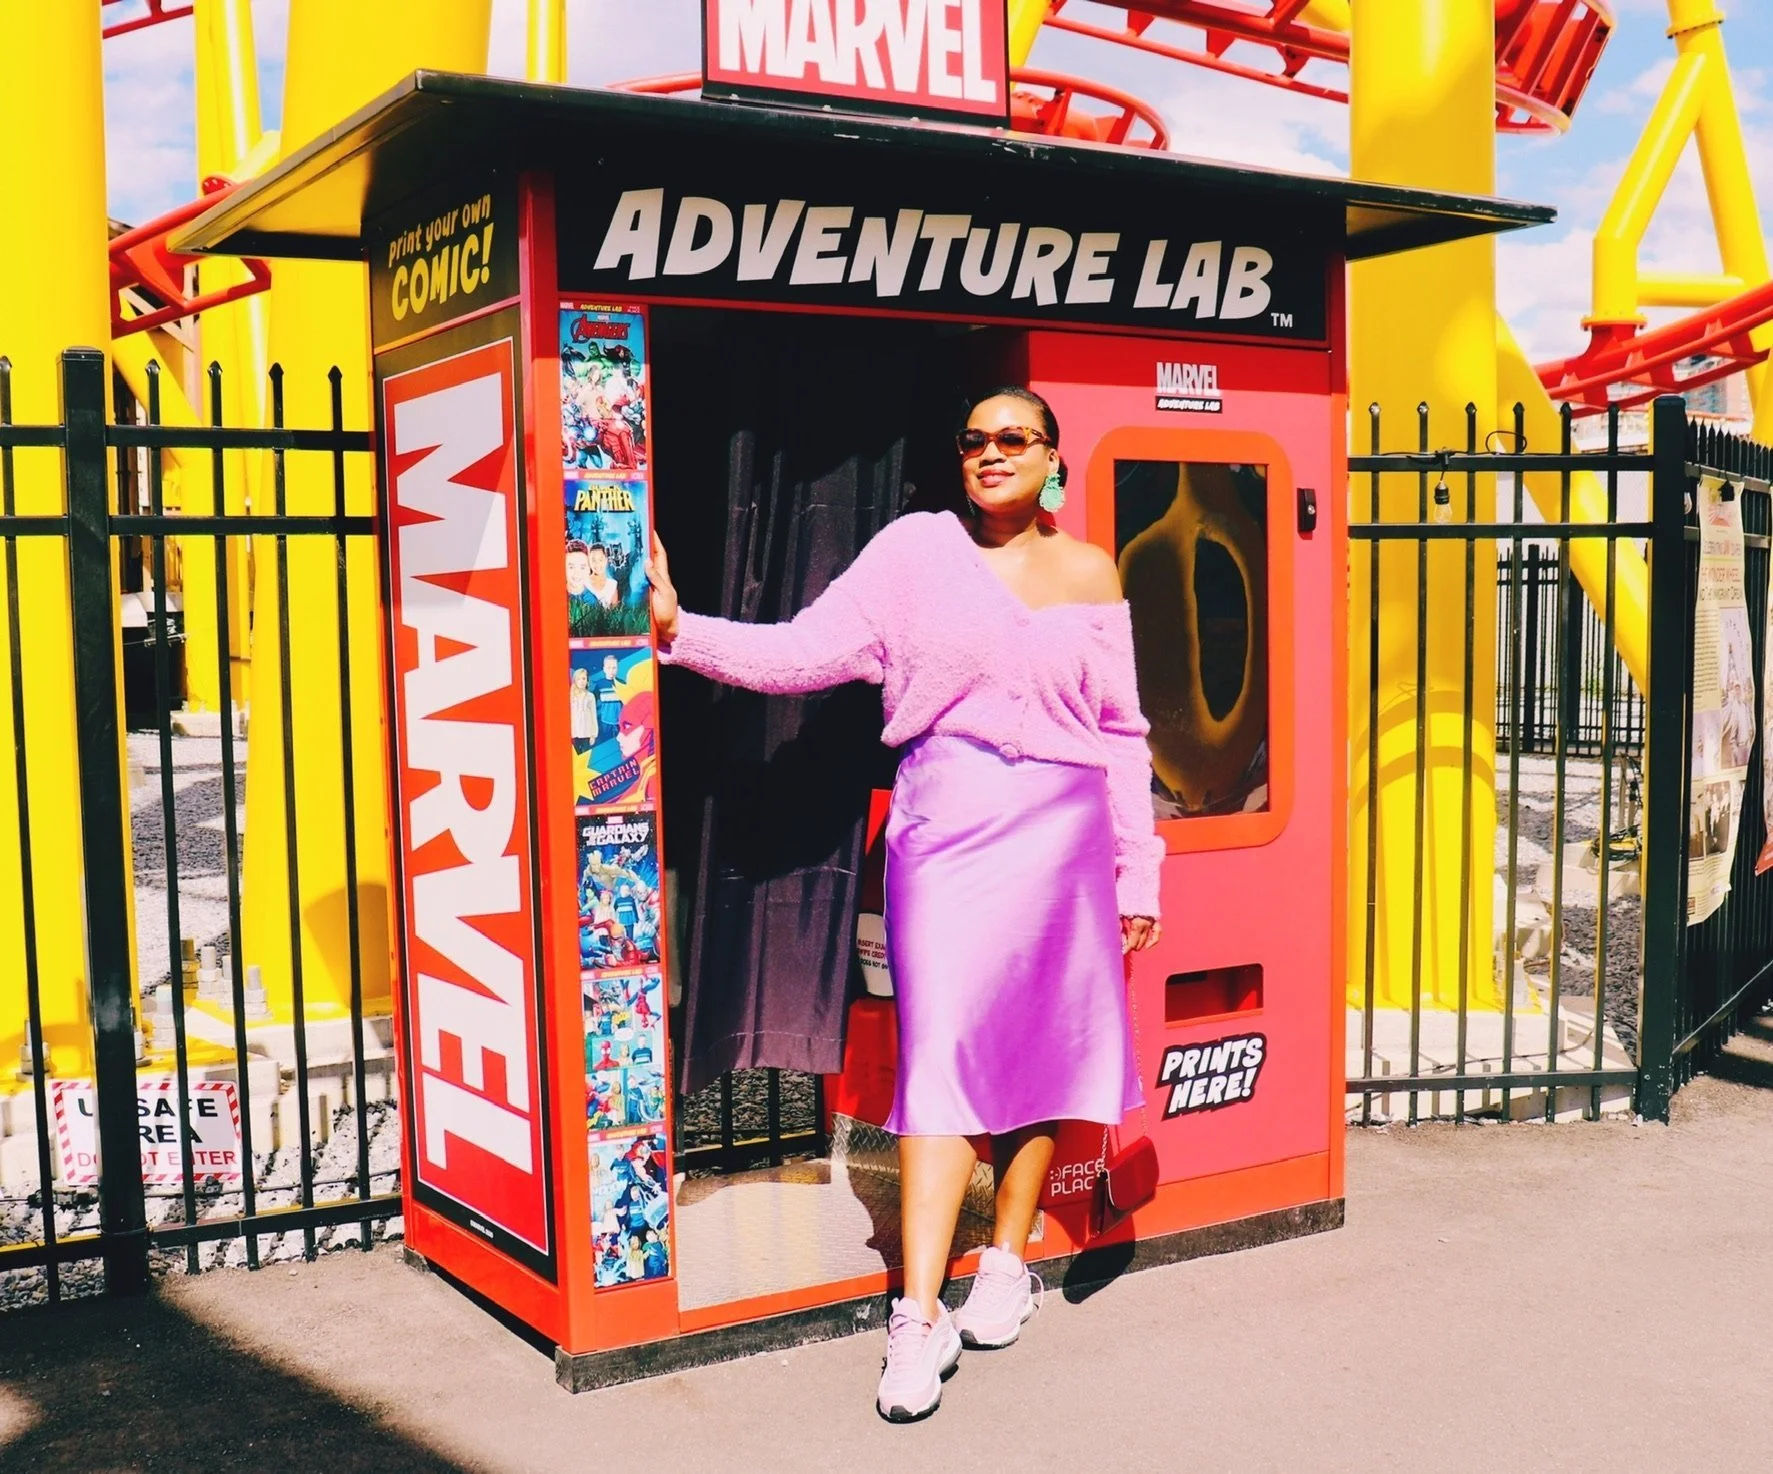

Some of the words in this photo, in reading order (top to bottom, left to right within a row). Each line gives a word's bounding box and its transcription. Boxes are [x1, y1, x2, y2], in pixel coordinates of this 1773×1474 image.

[719, 0, 996, 103] MARVEL
[388, 224, 422, 269] print
[425, 208, 459, 252] your
[462, 193, 491, 229] own
[593, 187, 1121, 307] ADVENTURE
[1133, 240, 1274, 320] LAB
[391, 222, 495, 322] COMIC!
[1156, 361, 1222, 397] MARVEL
[1157, 399, 1205, 410] ADVENTURE
[1204, 401, 1221, 411] LAB
[574, 489, 635, 512] PANTHER
[392, 372, 535, 1177] MARVEL
[590, 759, 637, 790] CAPTAIN
[592, 767, 640, 797] MARVEL
[582, 822, 649, 837] GUARDIANS
[597, 831, 647, 846] GALAXY
[1161, 1037, 1263, 1082] PRINTS
[1168, 1067, 1258, 1114] HERE!
[78, 1098, 218, 1117] USAE
[138, 1125, 203, 1143] REA
[168, 1151, 236, 1166] ETER
[1051, 1176, 1095, 1197] PLAC
